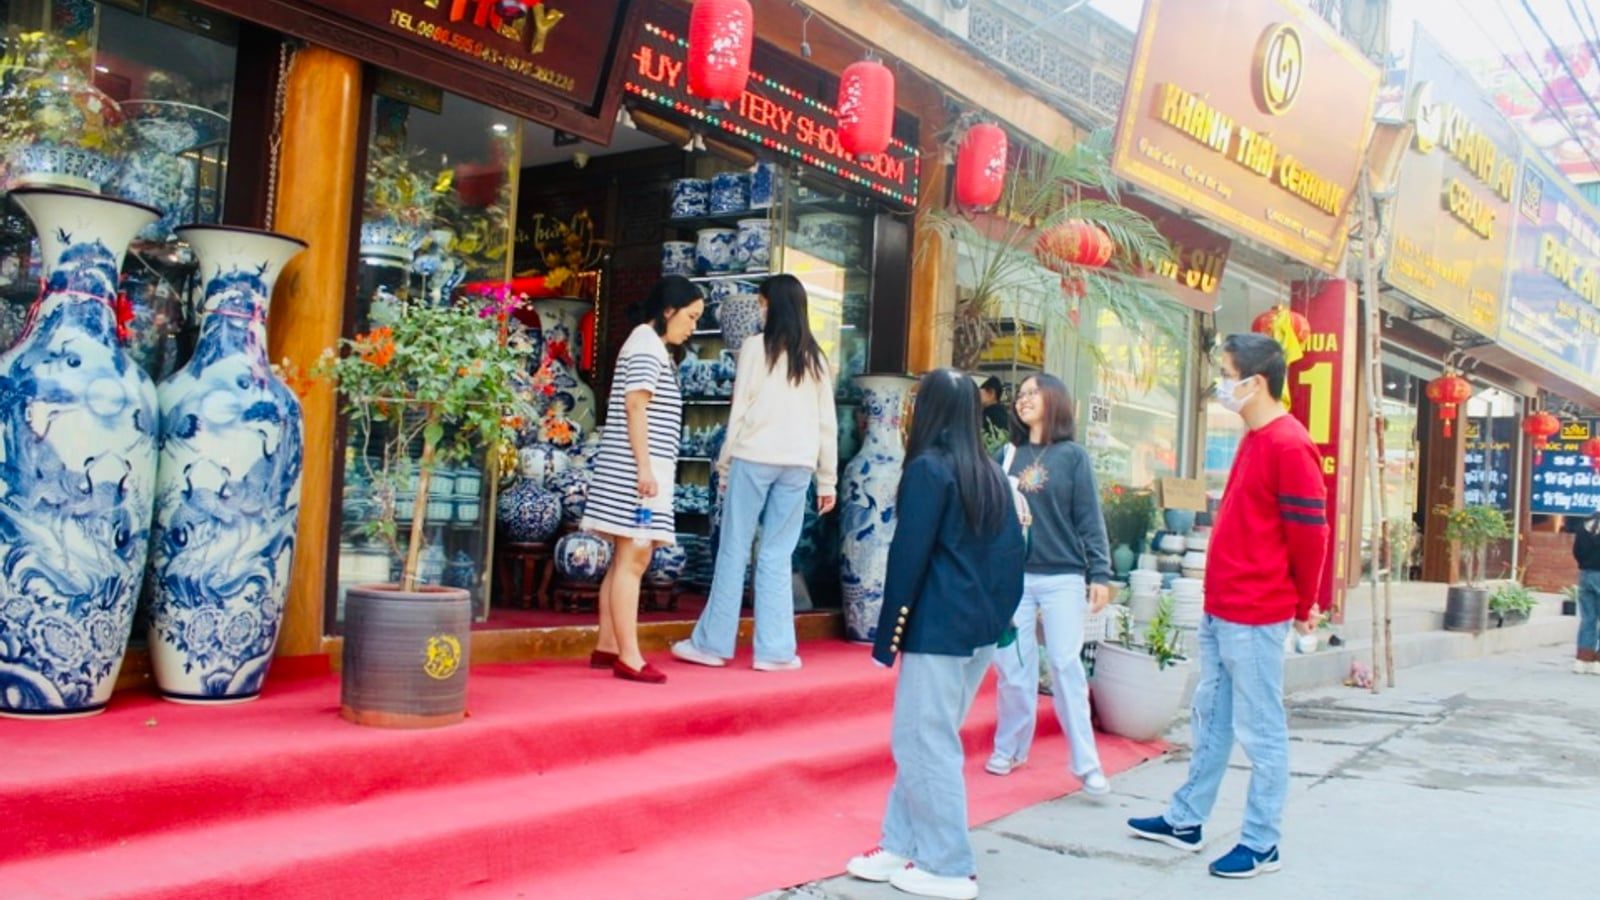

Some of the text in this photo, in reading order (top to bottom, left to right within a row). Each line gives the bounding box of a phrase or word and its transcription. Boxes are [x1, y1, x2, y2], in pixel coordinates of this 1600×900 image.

[797, 116, 904, 184] SHOOM
[1236, 126, 1277, 178] THÁI
[1299, 362, 1333, 444] 1
